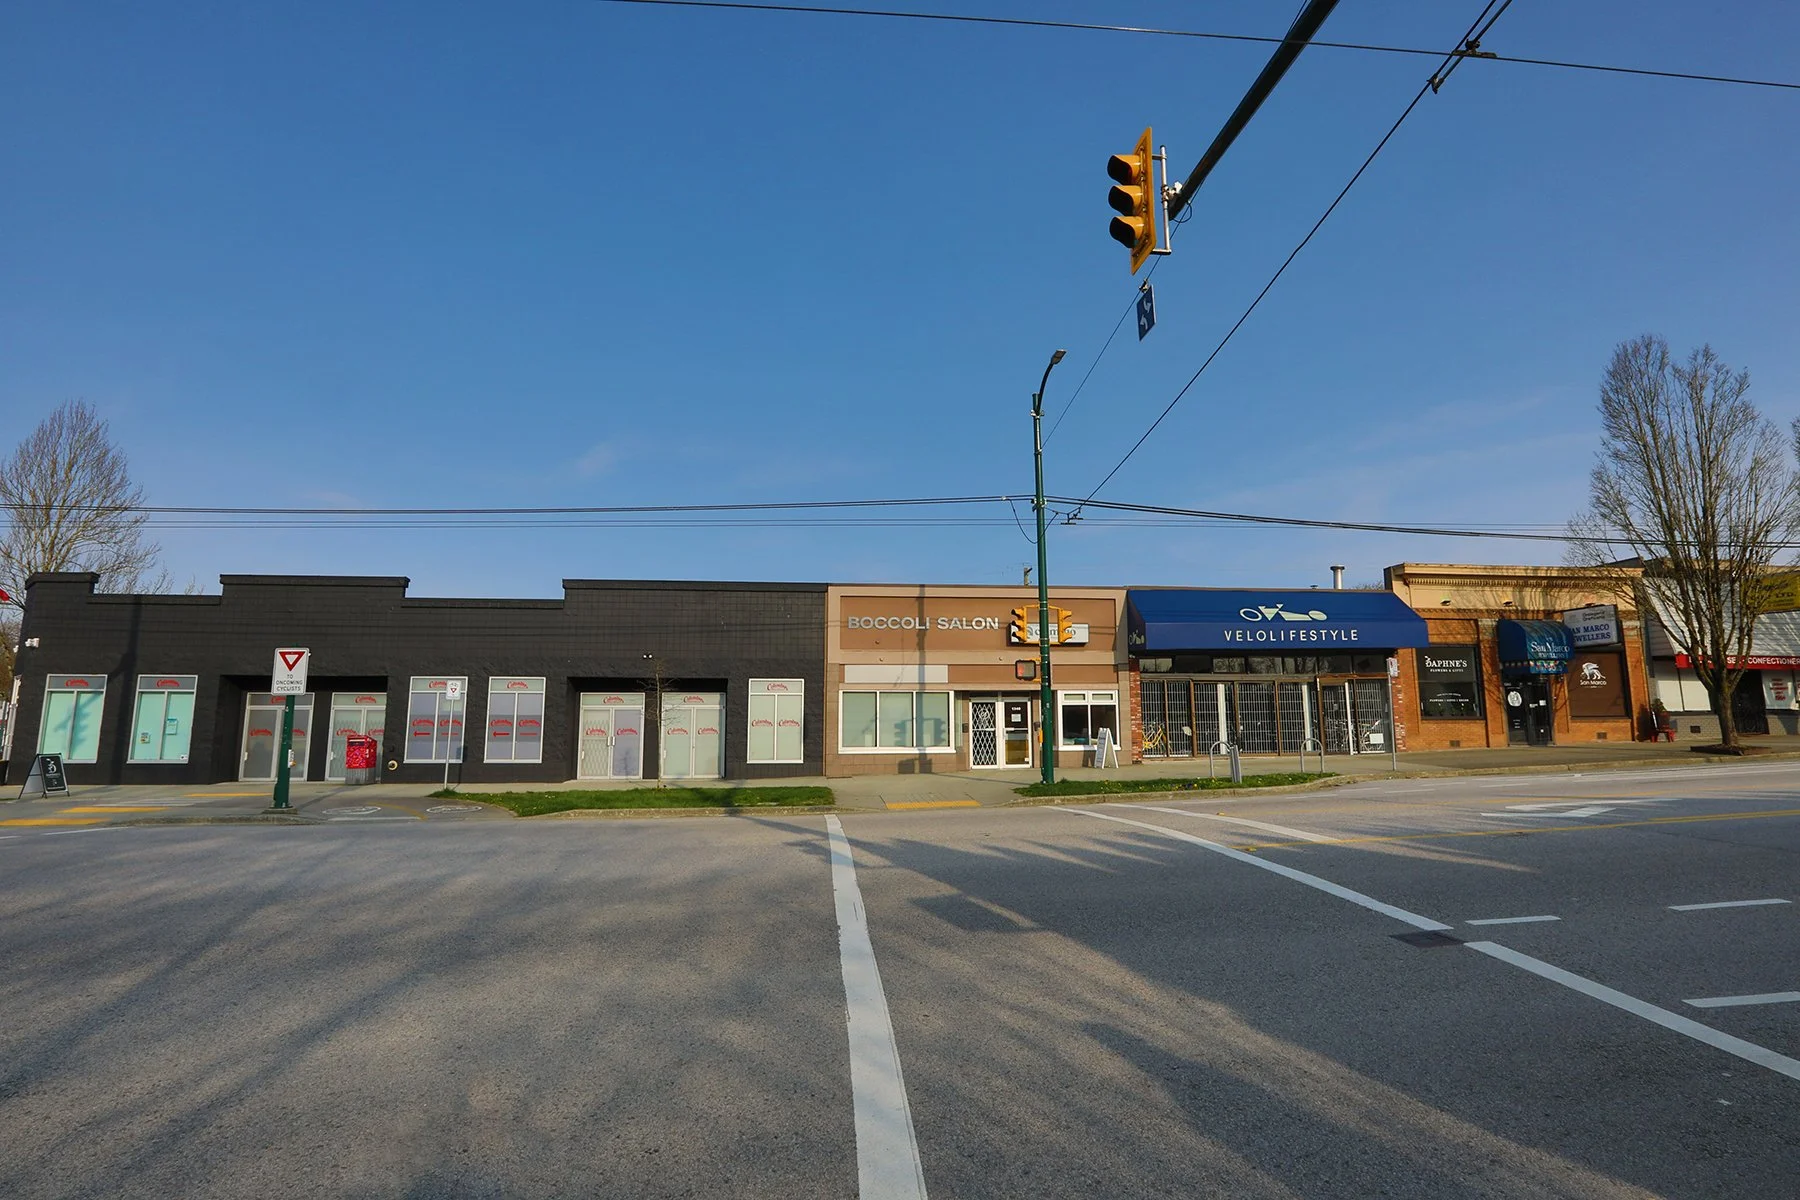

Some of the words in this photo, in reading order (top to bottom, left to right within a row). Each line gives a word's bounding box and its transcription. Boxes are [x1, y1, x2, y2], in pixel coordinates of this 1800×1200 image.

[848, 616, 930, 630] BOCCOLI
[937, 616, 999, 630] SALON
[1583, 623, 1610, 632] MARCO
[1224, 629, 1359, 642] VELOLIFESTYLE
[1425, 657, 1468, 668] DAPHNE'S
